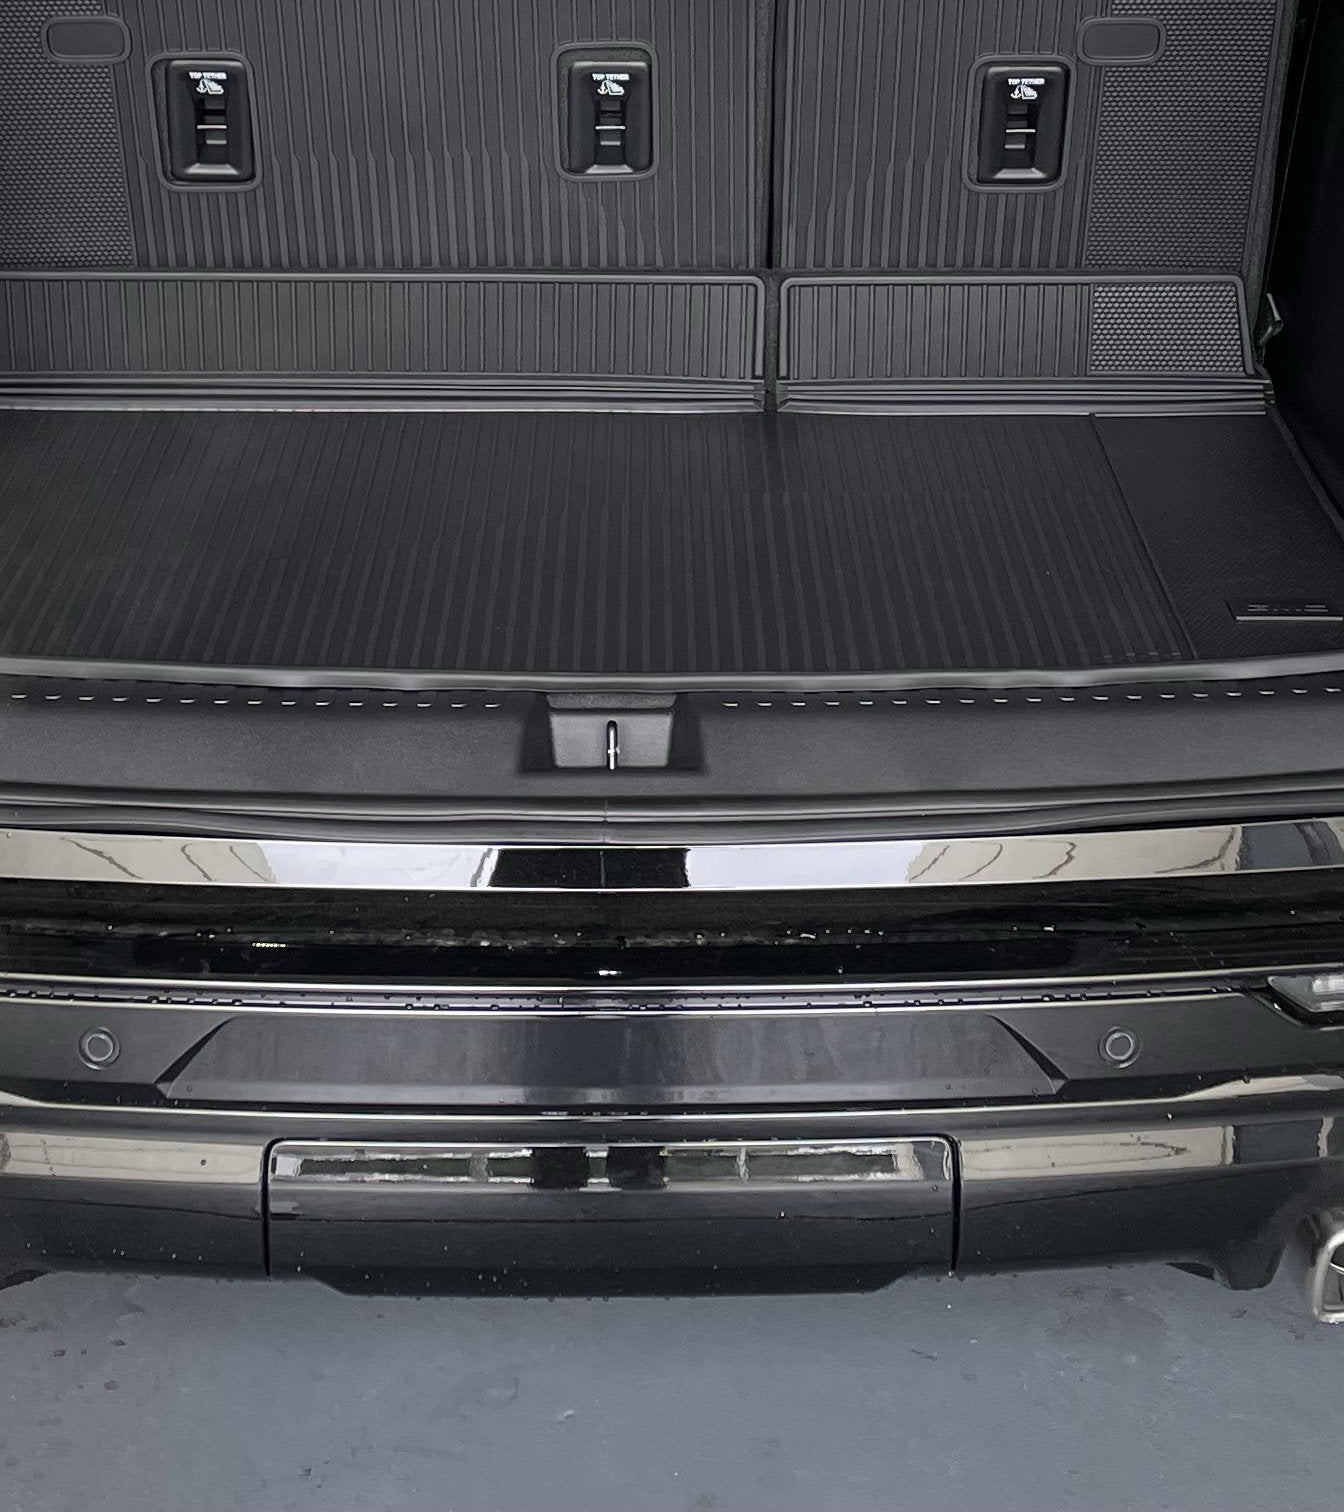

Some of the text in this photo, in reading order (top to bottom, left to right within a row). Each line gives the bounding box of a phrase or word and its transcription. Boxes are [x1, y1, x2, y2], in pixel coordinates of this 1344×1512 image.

[189, 72, 202, 80] TOP
[592, 73, 605, 81] TOP
[1007, 78, 1020, 86] TOP
